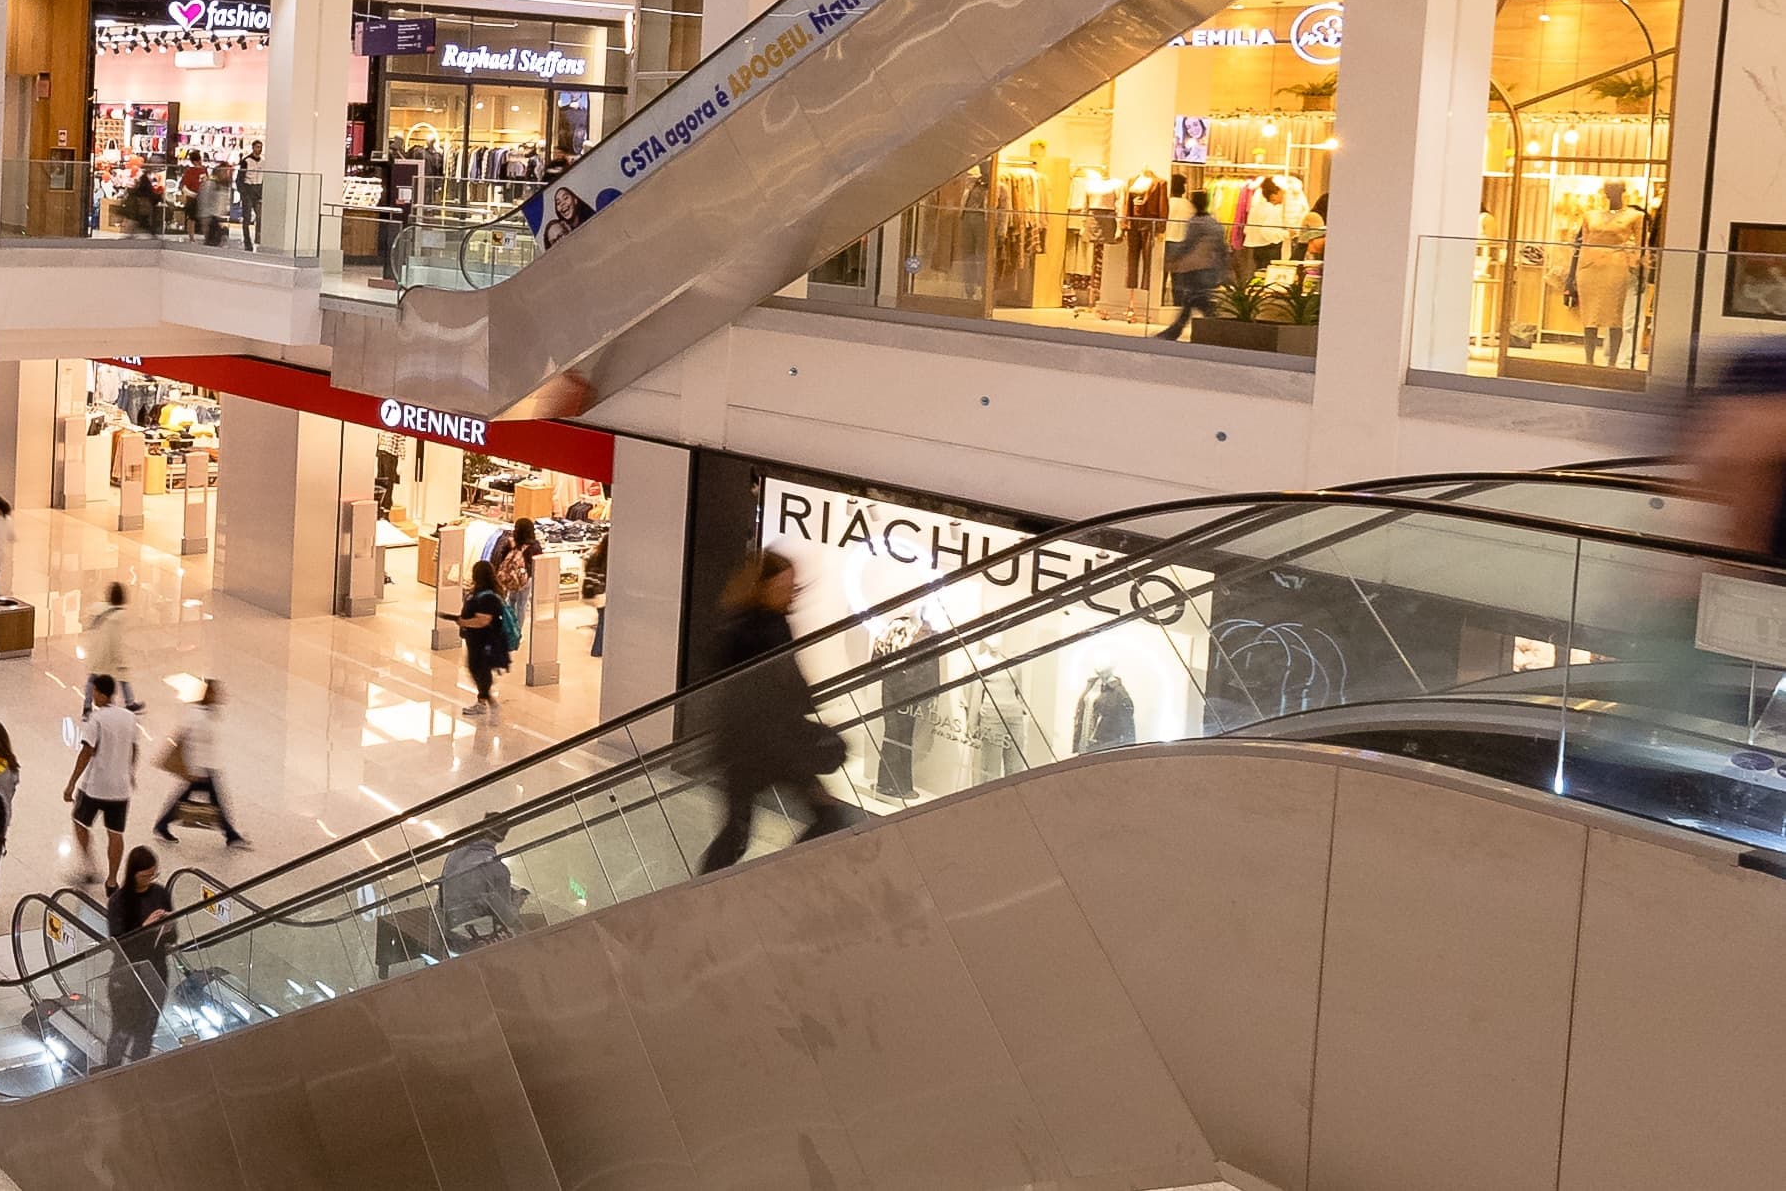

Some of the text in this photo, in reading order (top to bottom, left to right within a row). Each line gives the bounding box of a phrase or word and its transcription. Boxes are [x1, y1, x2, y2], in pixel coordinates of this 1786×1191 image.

[1191, 28, 1276, 47] EMILIA
[441, 44, 586, 78] Raphael Steffens
[620, 135, 667, 178] CSTA
[664, 100, 717, 145] agora
[714, 84, 730, 108] é
[727, 23, 814, 99] APOGEU.
[402, 404, 486, 446] RENNER
[778, 491, 1187, 626] RIACHUELO
